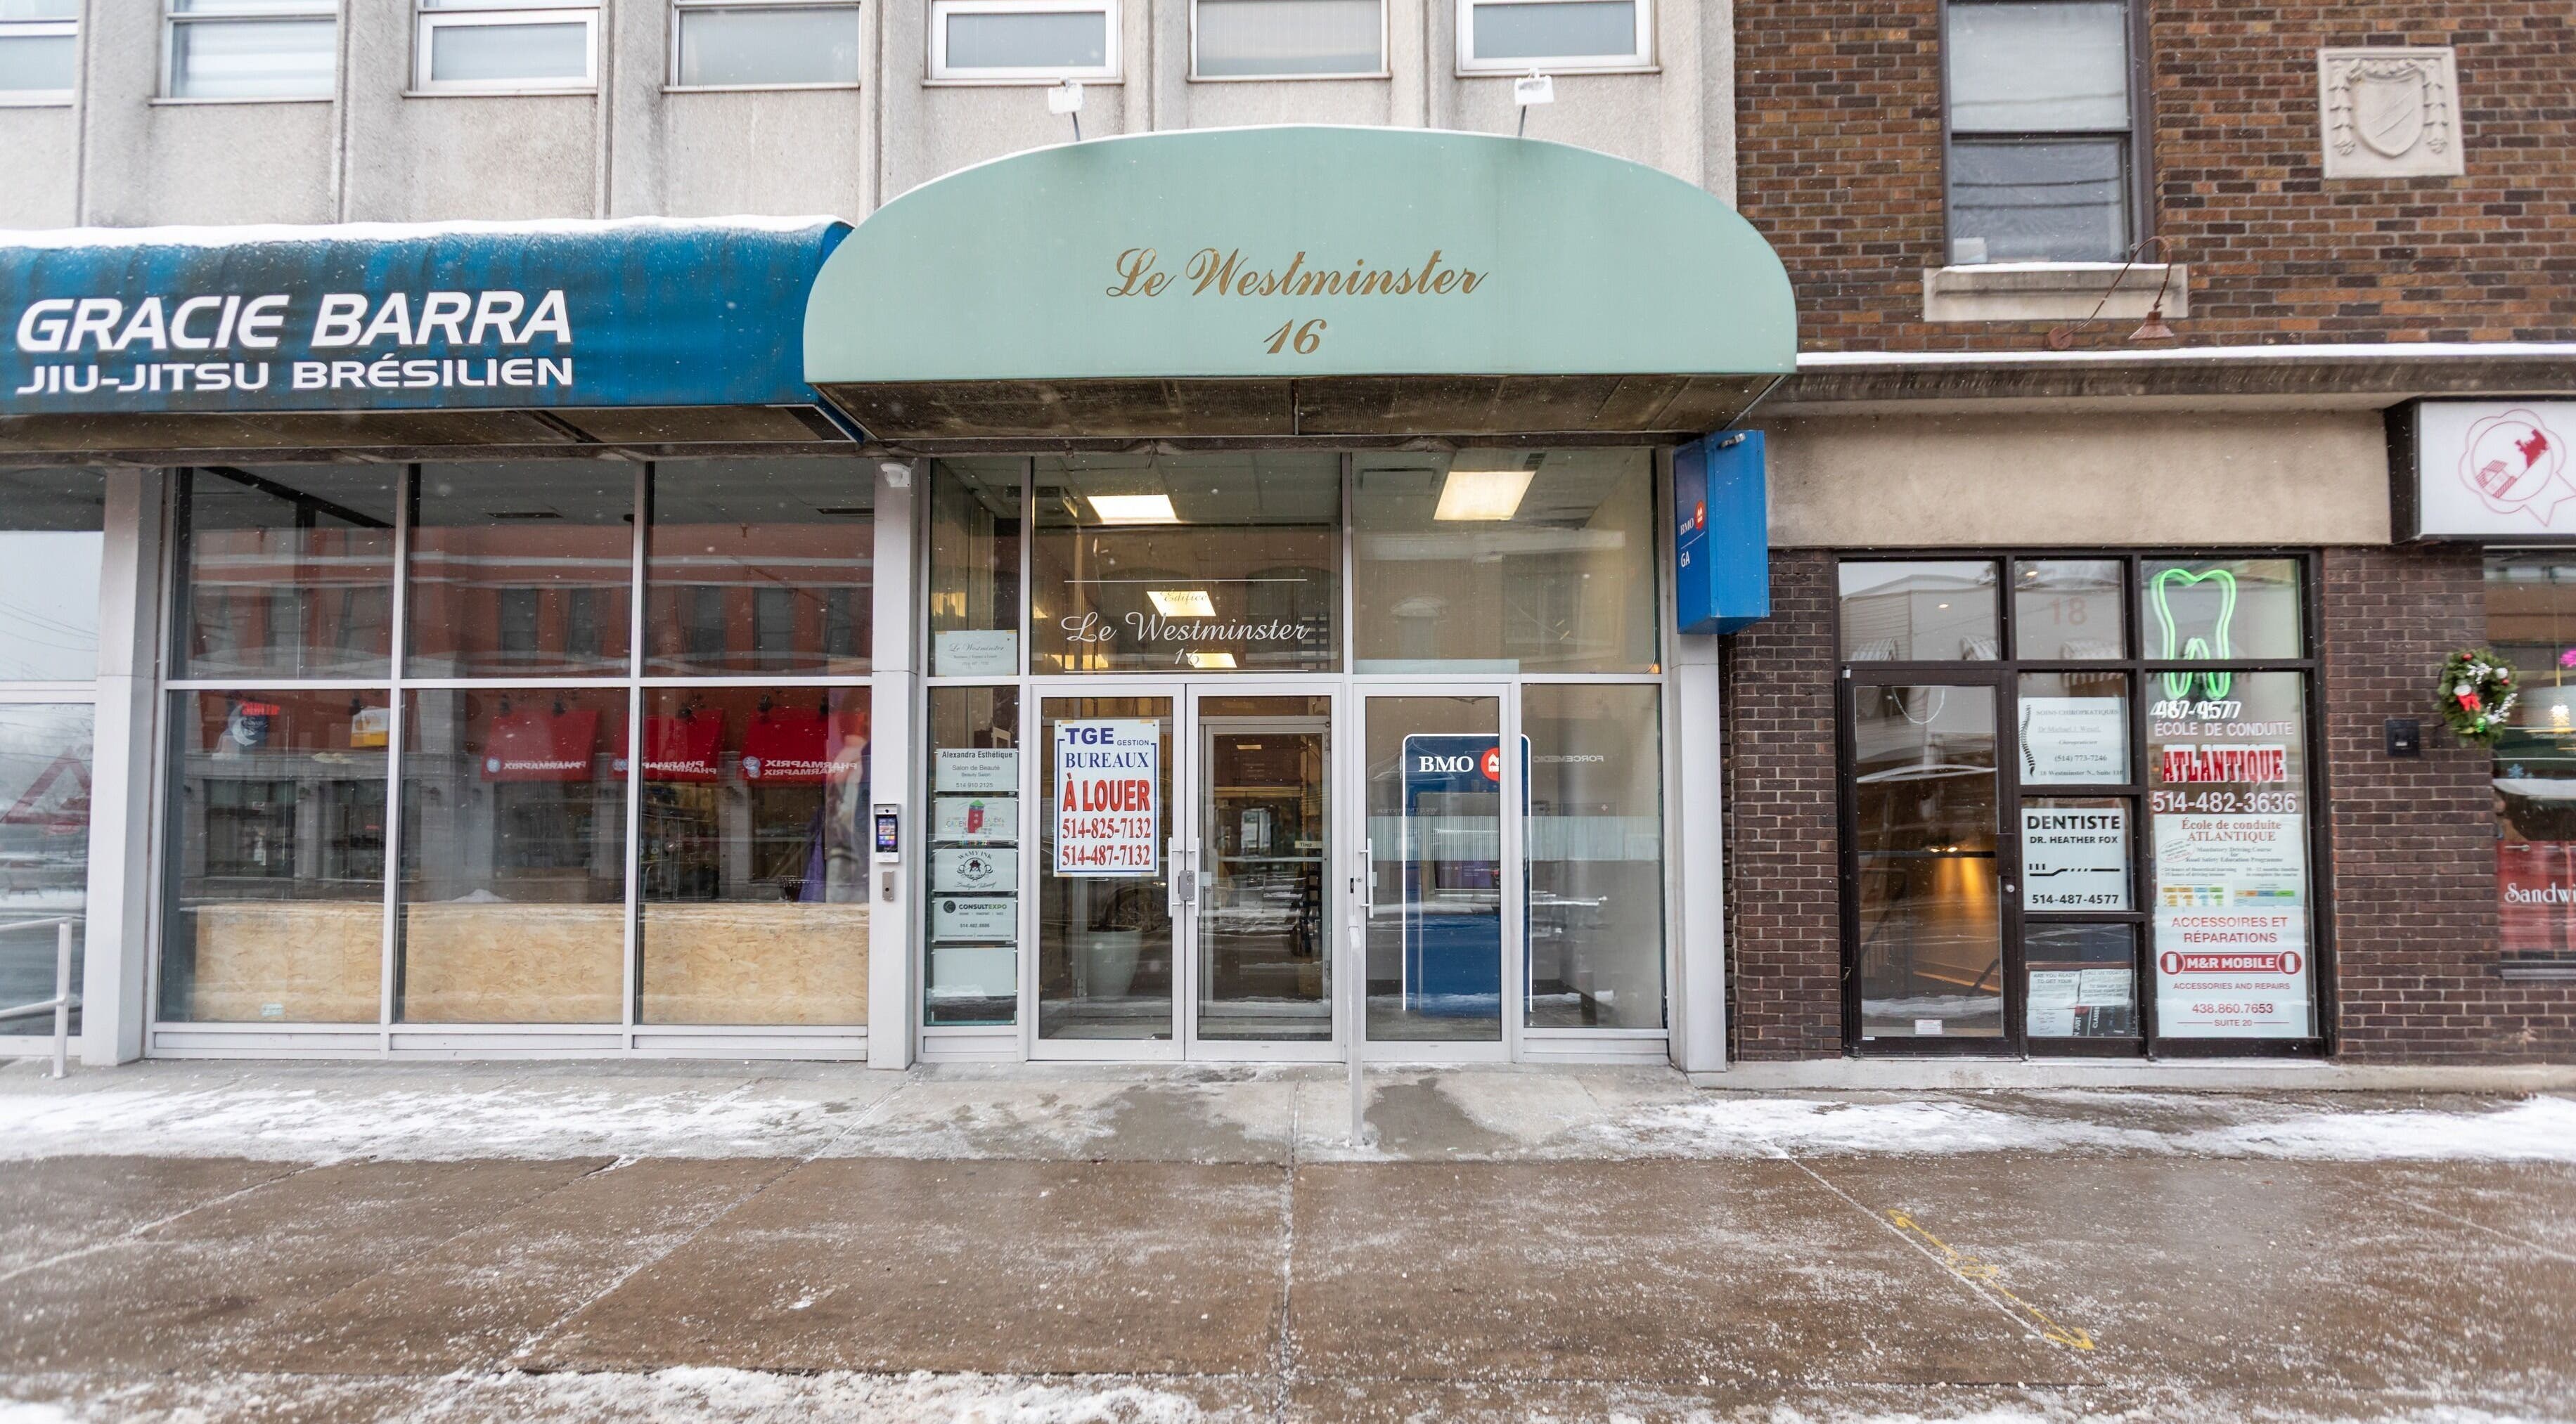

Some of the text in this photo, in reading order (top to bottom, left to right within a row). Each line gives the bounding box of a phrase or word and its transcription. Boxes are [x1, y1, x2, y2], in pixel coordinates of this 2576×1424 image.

[1106, 247, 1489, 297] Le Westminster
[15, 289, 573, 353] GRACIE BARRA
[1263, 318, 1327, 355] 16
[15, 353, 573, 395] JIU-JITSU BRÉSILIEN
[1680, 517, 1694, 536] BMO
[1680, 550, 1691, 569] GA
[2047, 595, 2088, 626] 18
[1060, 611, 1310, 643] Le Westminster
[1174, 647, 1200, 666] 16
[1064, 727, 1114, 745] TGE
[2154, 720, 2295, 737] ÉCOLE DE CONDUITE
[977, 751, 1013, 759] Esthétique
[1065, 752, 1149, 768] BUREAUX
[1418, 756, 1474, 772] BMO
[2163, 745, 2287, 785] ATLANTIQUE
[1062, 772, 1151, 813] À LOUER
[2152, 791, 2297, 813] 514-482-3636
[1062, 817, 1152, 839] 514-825-7132
[2027, 815, 2121, 830] DENTISTE
[2182, 817, 2282, 829] École de conduite
[2187, 831, 2276, 843] ATLANTIQUE
[1062, 844, 1151, 867] 514-487-7132
[2032, 893, 2120, 905] 514-487-4577
[2171, 917, 2288, 928] ACCESSOIRES ET
[2184, 930, 2278, 943] RÉPARATIONS
[2187, 957, 2275, 969] M&R MOBILE
[2192, 1003, 2274, 1014] 438.860.7653
